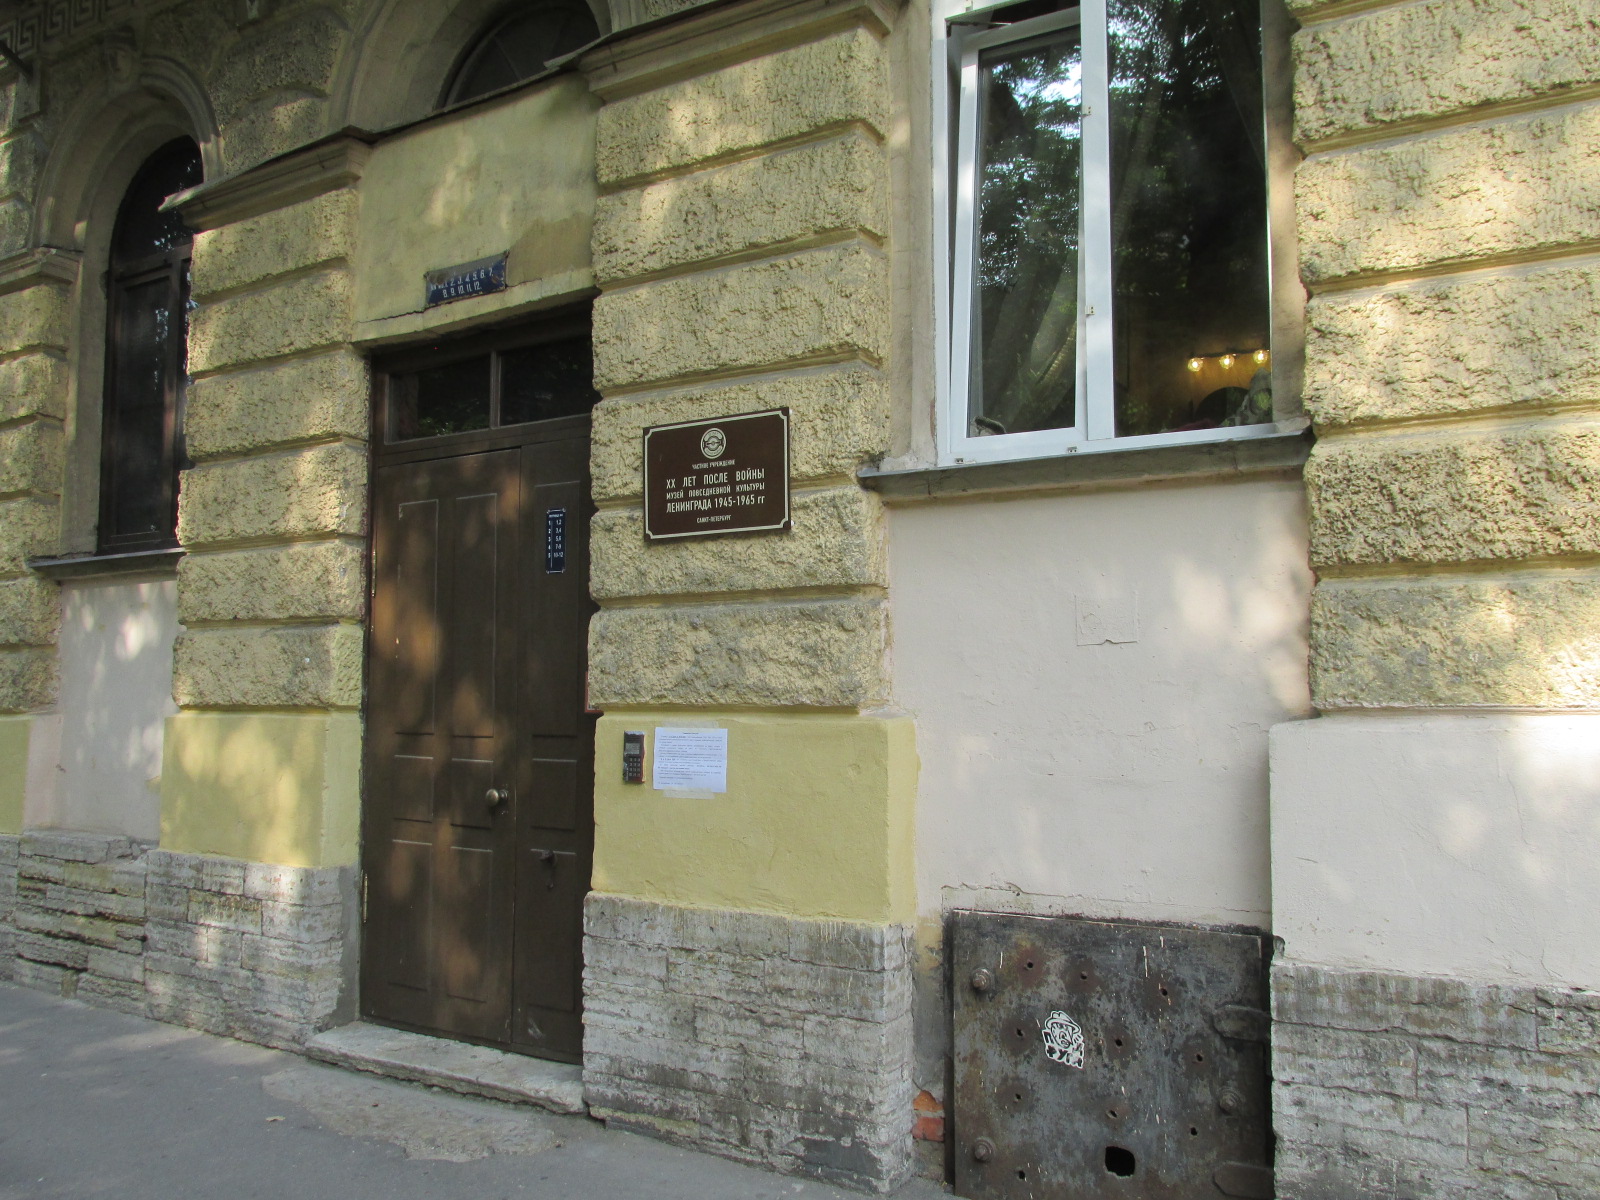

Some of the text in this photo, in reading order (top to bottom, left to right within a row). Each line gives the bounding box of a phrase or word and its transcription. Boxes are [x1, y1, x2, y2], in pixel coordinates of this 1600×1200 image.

[682, 476, 696, 486] ЛЕТ
[703, 472, 728, 484] ПОСЛЕ
[735, 468, 765, 482] ВОЙНЫ
[666, 482, 765, 500] МУЗЕЙ ПОВСЕДНЕВНОЙ КУЛЬТУРЫ
[666, 494, 765, 512] ЛЕНИНГРАДА 1945-1965 гг
[696, 514, 732, 524] САНКТ-ПЕТЕРБУРГ
